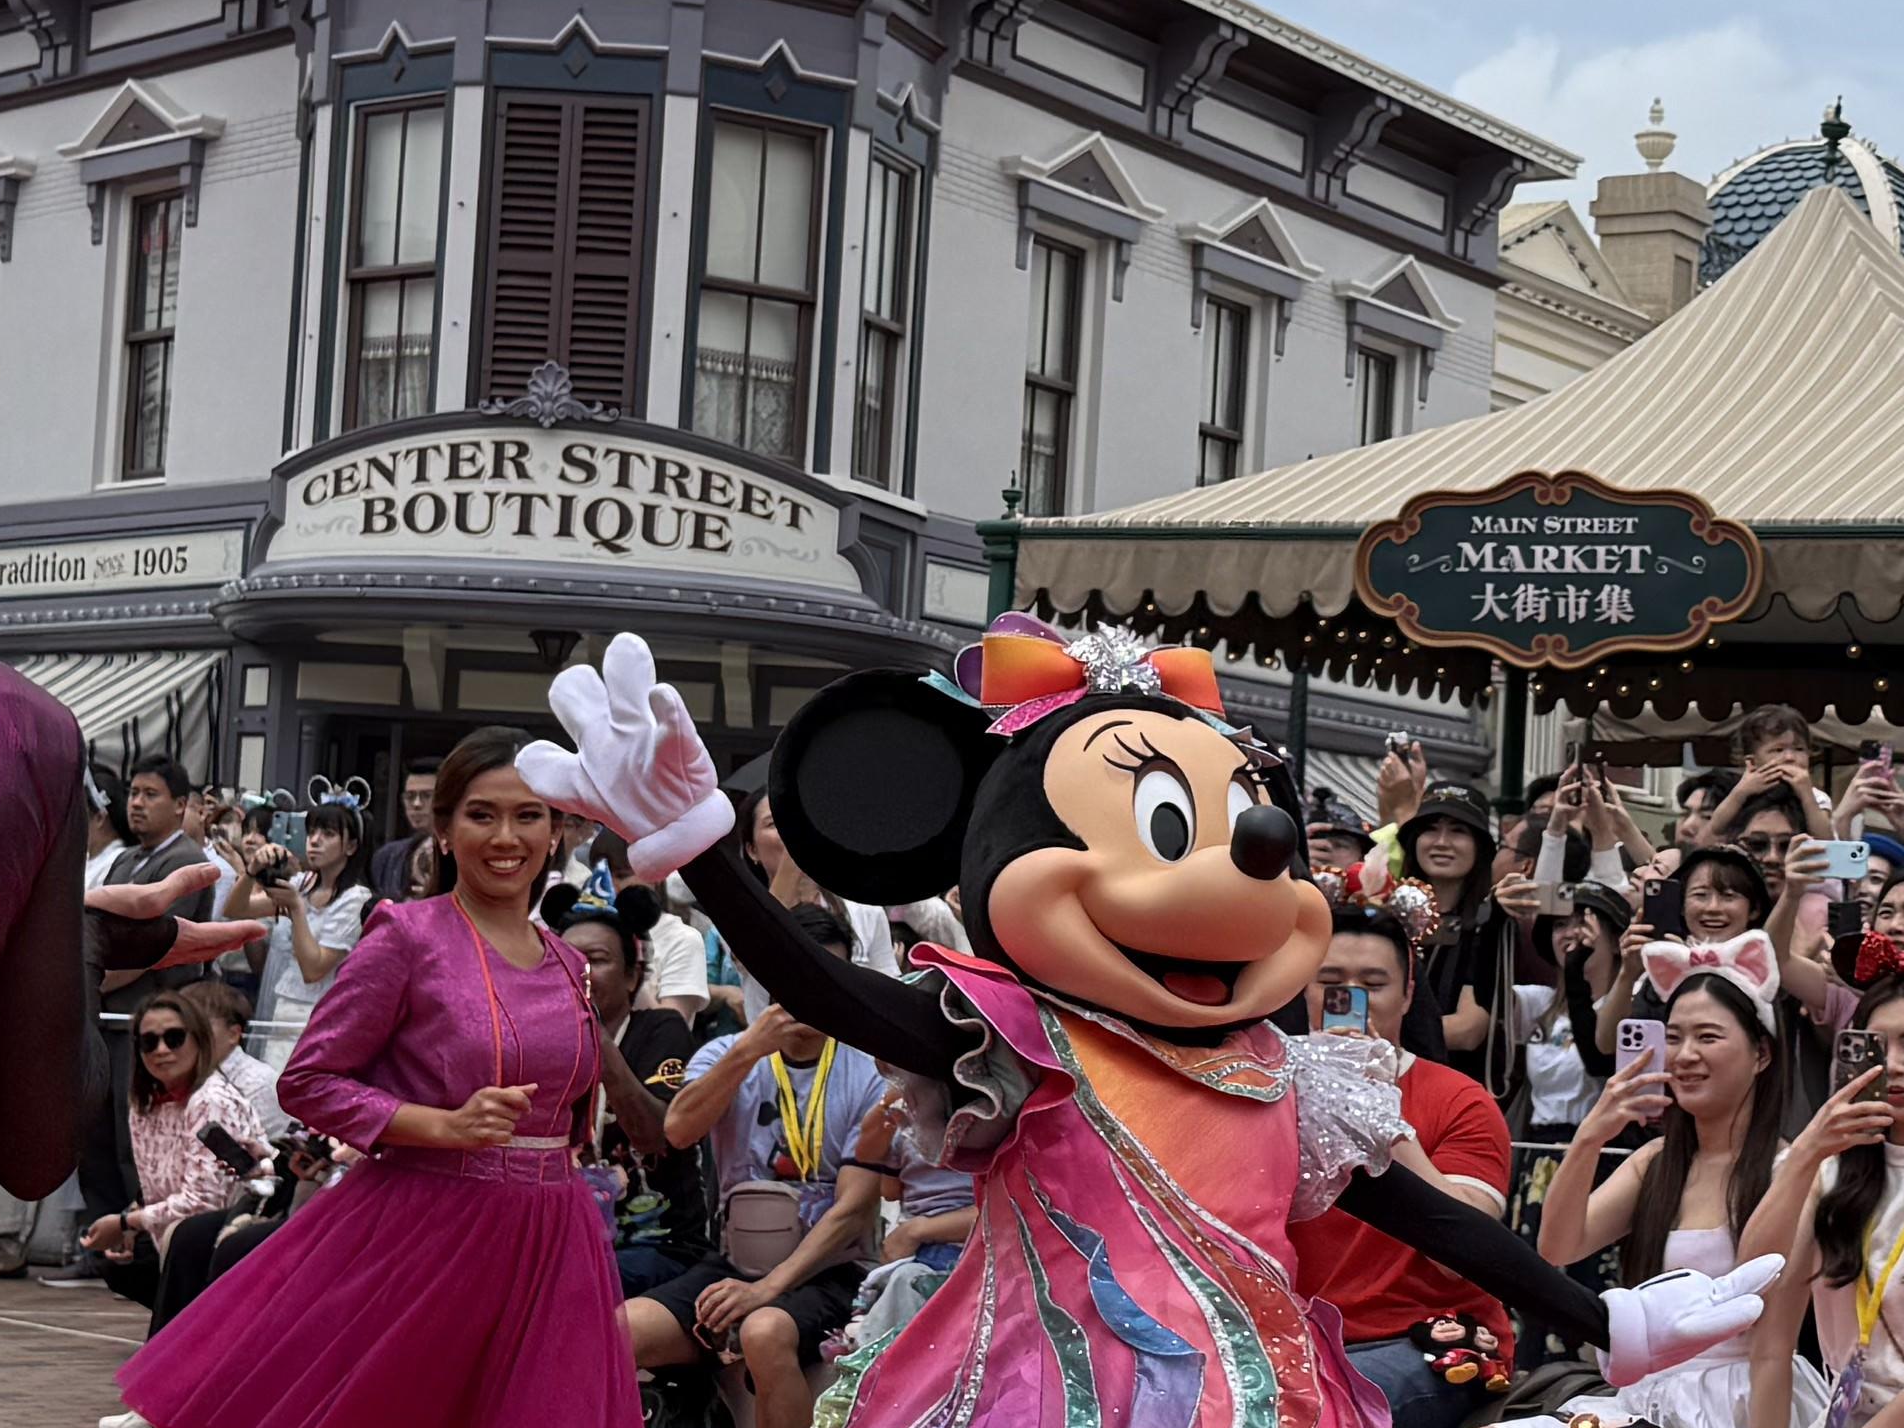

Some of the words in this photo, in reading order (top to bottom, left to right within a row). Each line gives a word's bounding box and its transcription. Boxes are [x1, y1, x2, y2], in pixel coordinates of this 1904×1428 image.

[302, 439, 534, 508] CENTER
[557, 441, 816, 533] STREET
[360, 491, 734, 556] BOUTIQUE
[1470, 515, 1538, 535] MAIN
[1543, 515, 1639, 535] STREET
[133, 545, 189, 576] 1905
[1455, 542, 1652, 575] MARKET
[1471, 582, 1636, 625] 大街市集
